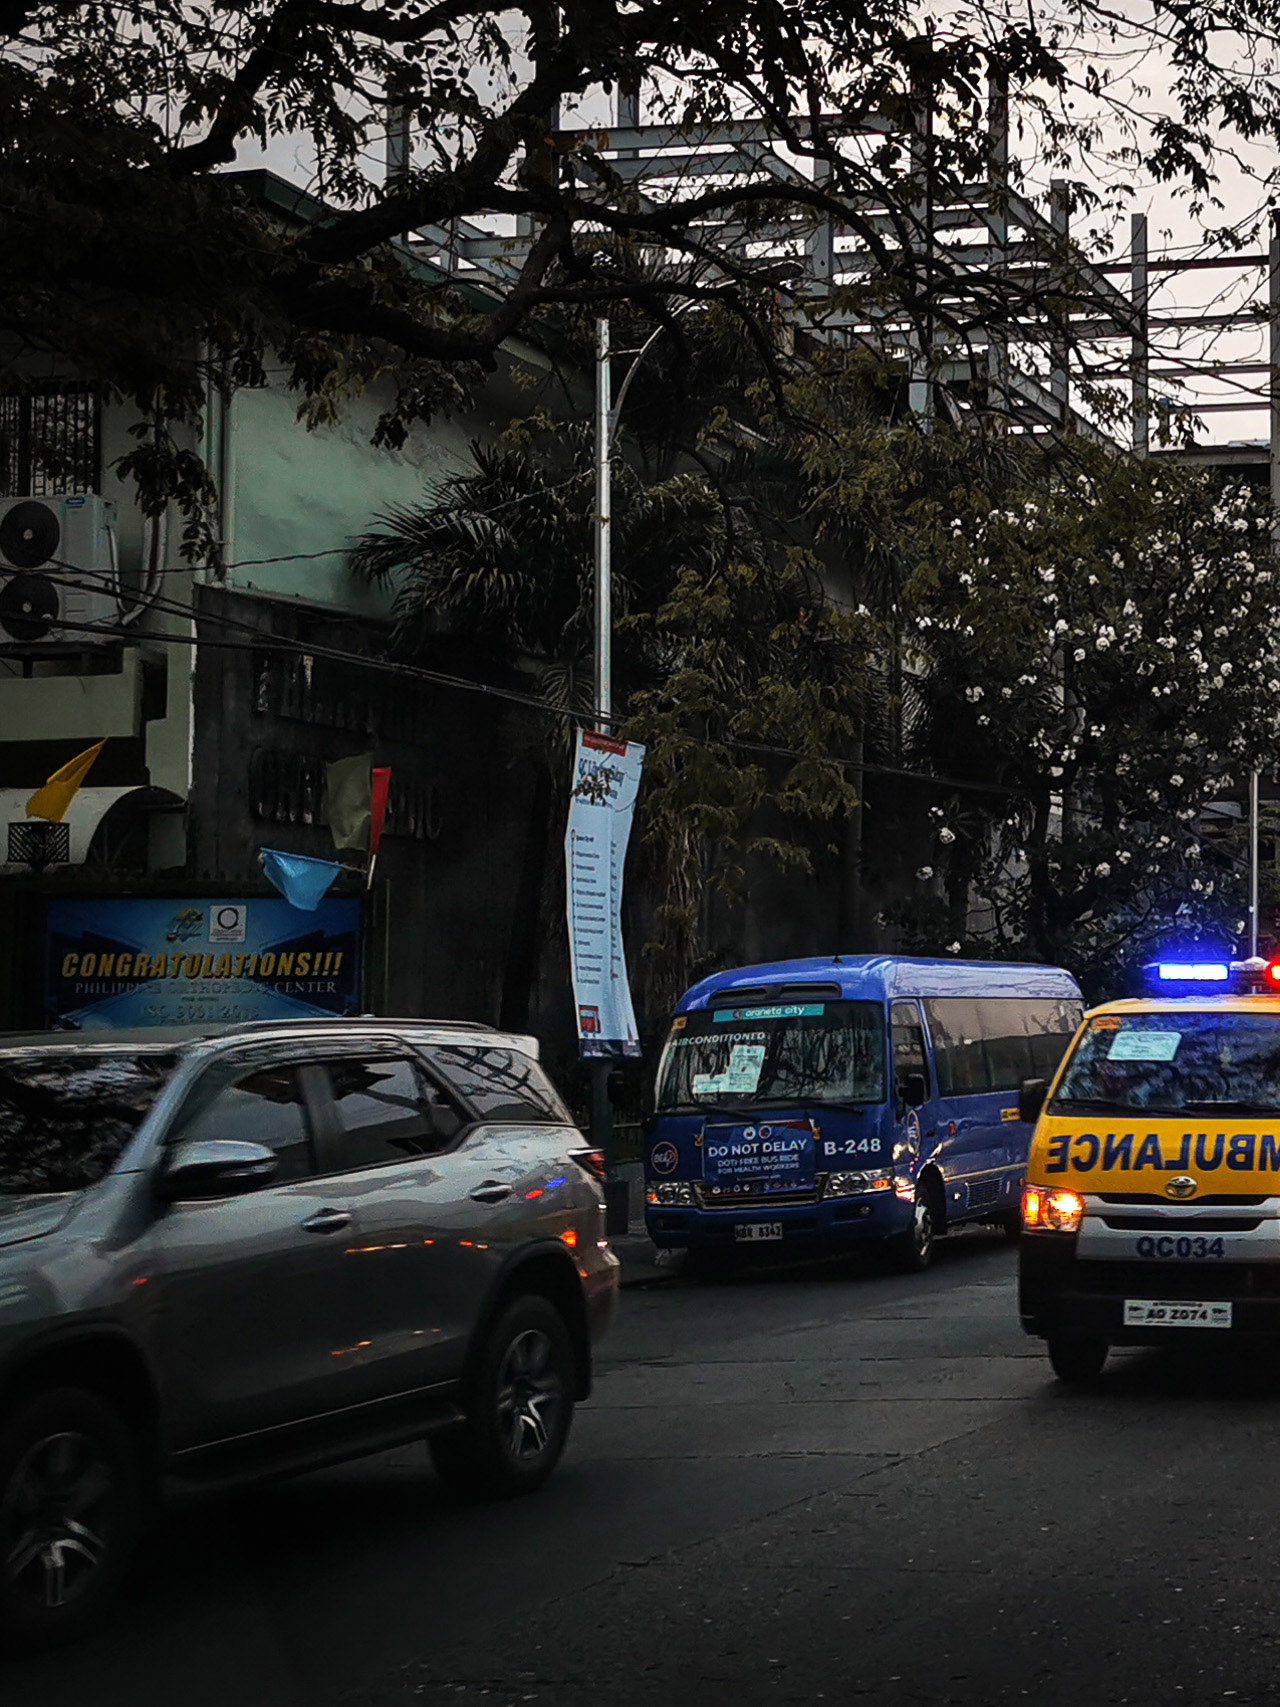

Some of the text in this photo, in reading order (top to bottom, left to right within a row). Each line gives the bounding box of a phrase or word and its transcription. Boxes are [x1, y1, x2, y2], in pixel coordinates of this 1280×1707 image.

[61, 952, 344, 979] CONGRATULATIONS!!!
[274, 981, 337, 994] CENTER
[745, 1005, 806, 1017] araneta city
[672, 1031, 767, 1047] AIRCONDITIONED
[708, 1138, 808, 1158] DO NOT DELAY
[823, 1138, 882, 1156] B-248
[740, 1157, 760, 1165] FREE
[761, 1156, 778, 1164] BUS
[780, 1154, 800, 1162] RIDE
[717, 1162, 800, 1175] FOR HEALTH WORKERS
[1136, 1236, 1224, 1258] QC034
